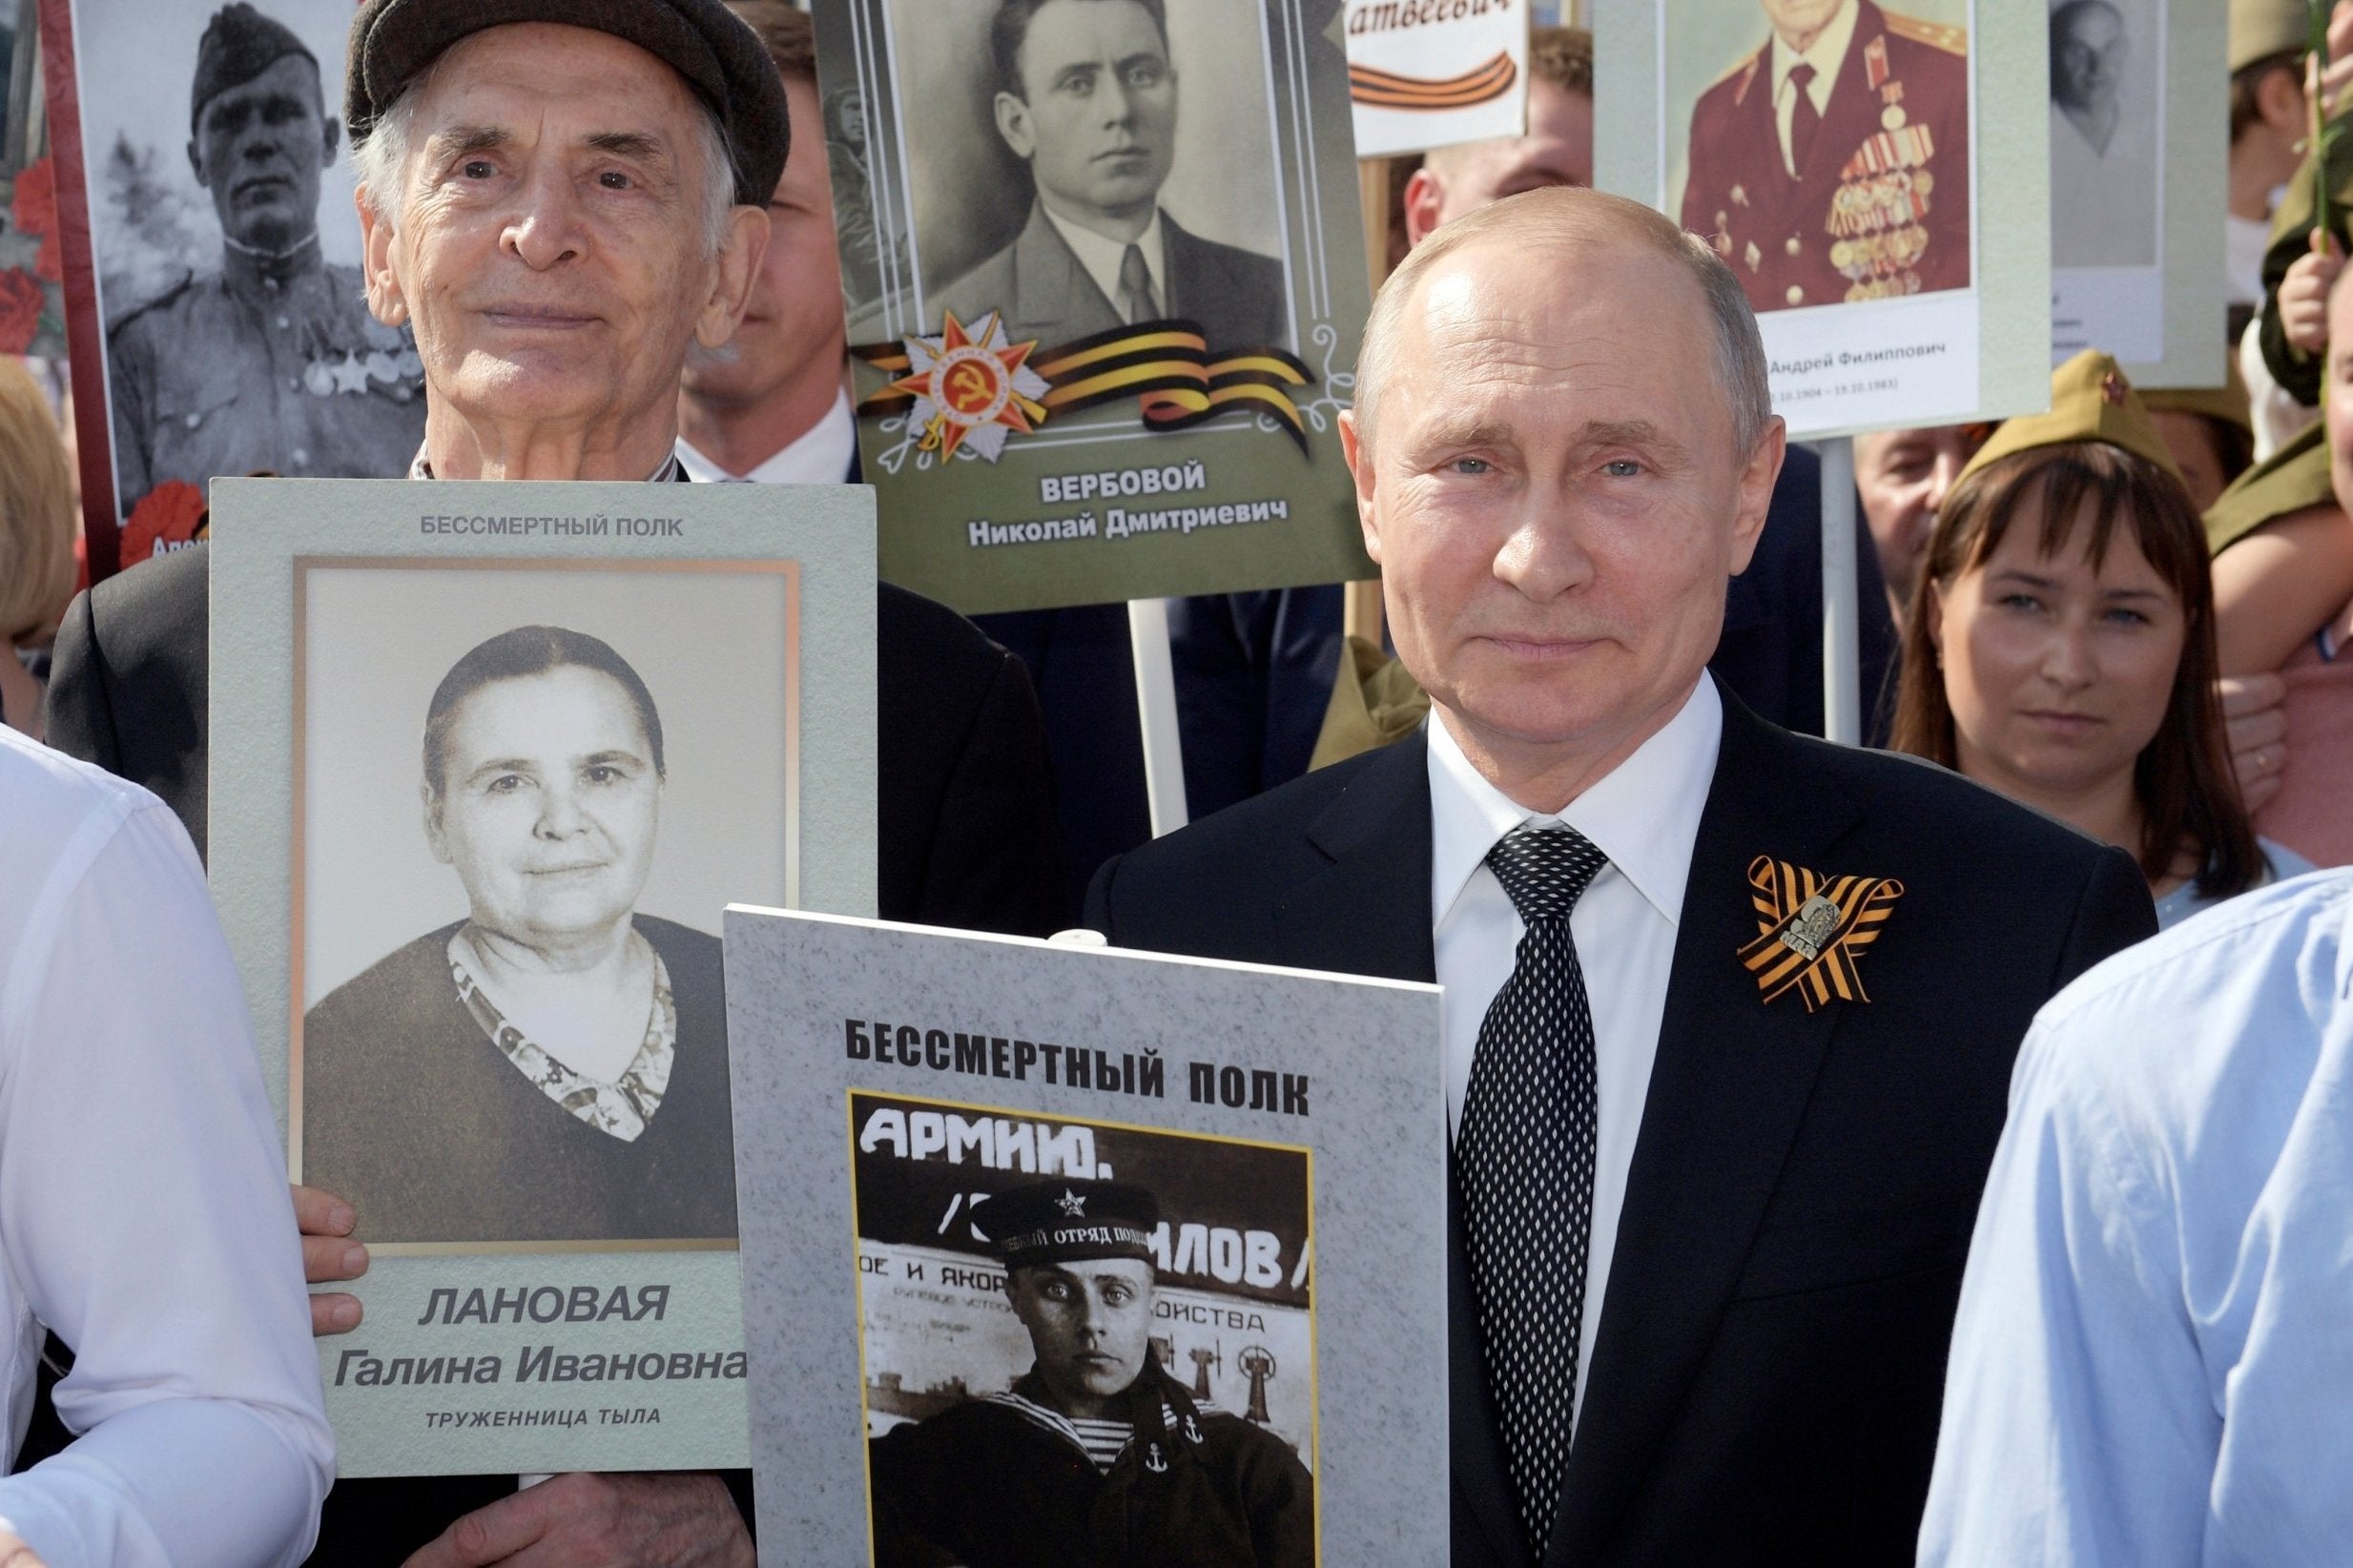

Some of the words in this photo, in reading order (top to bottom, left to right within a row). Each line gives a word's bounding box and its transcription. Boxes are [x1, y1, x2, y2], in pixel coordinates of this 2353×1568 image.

[1343, 0, 1511, 34] атвеевич
[1769, 353, 1834, 376] Андрей
[1839, 342, 1947, 366] Филиппович
[1041, 460, 1207, 503] ВЕРБОВОЙ
[420, 513, 609, 536] БЕССМЕРТНЫЙ
[615, 517, 685, 537] ПОЛК
[968, 512, 1097, 547] Николай
[1104, 501, 1288, 540] Дмитриевич
[845, 1018, 1165, 1099] БЕССМЕРТНЫЙ
[1188, 1062, 1310, 1117] ПОЛК
[859, 1107, 1114, 1181] АРМИЮ.
[1054, 1227, 1112, 1246] ОТРЯД
[907, 1263, 923, 1281] И
[418, 1284, 671, 1326] ЛАНОВАЯ
[334, 1347, 503, 1387] Галина
[515, 1345, 749, 1383] Ивановна
[425, 1410, 588, 1430] ТРУЖЕННИЦА
[598, 1408, 662, 1426] ТЫЛА
